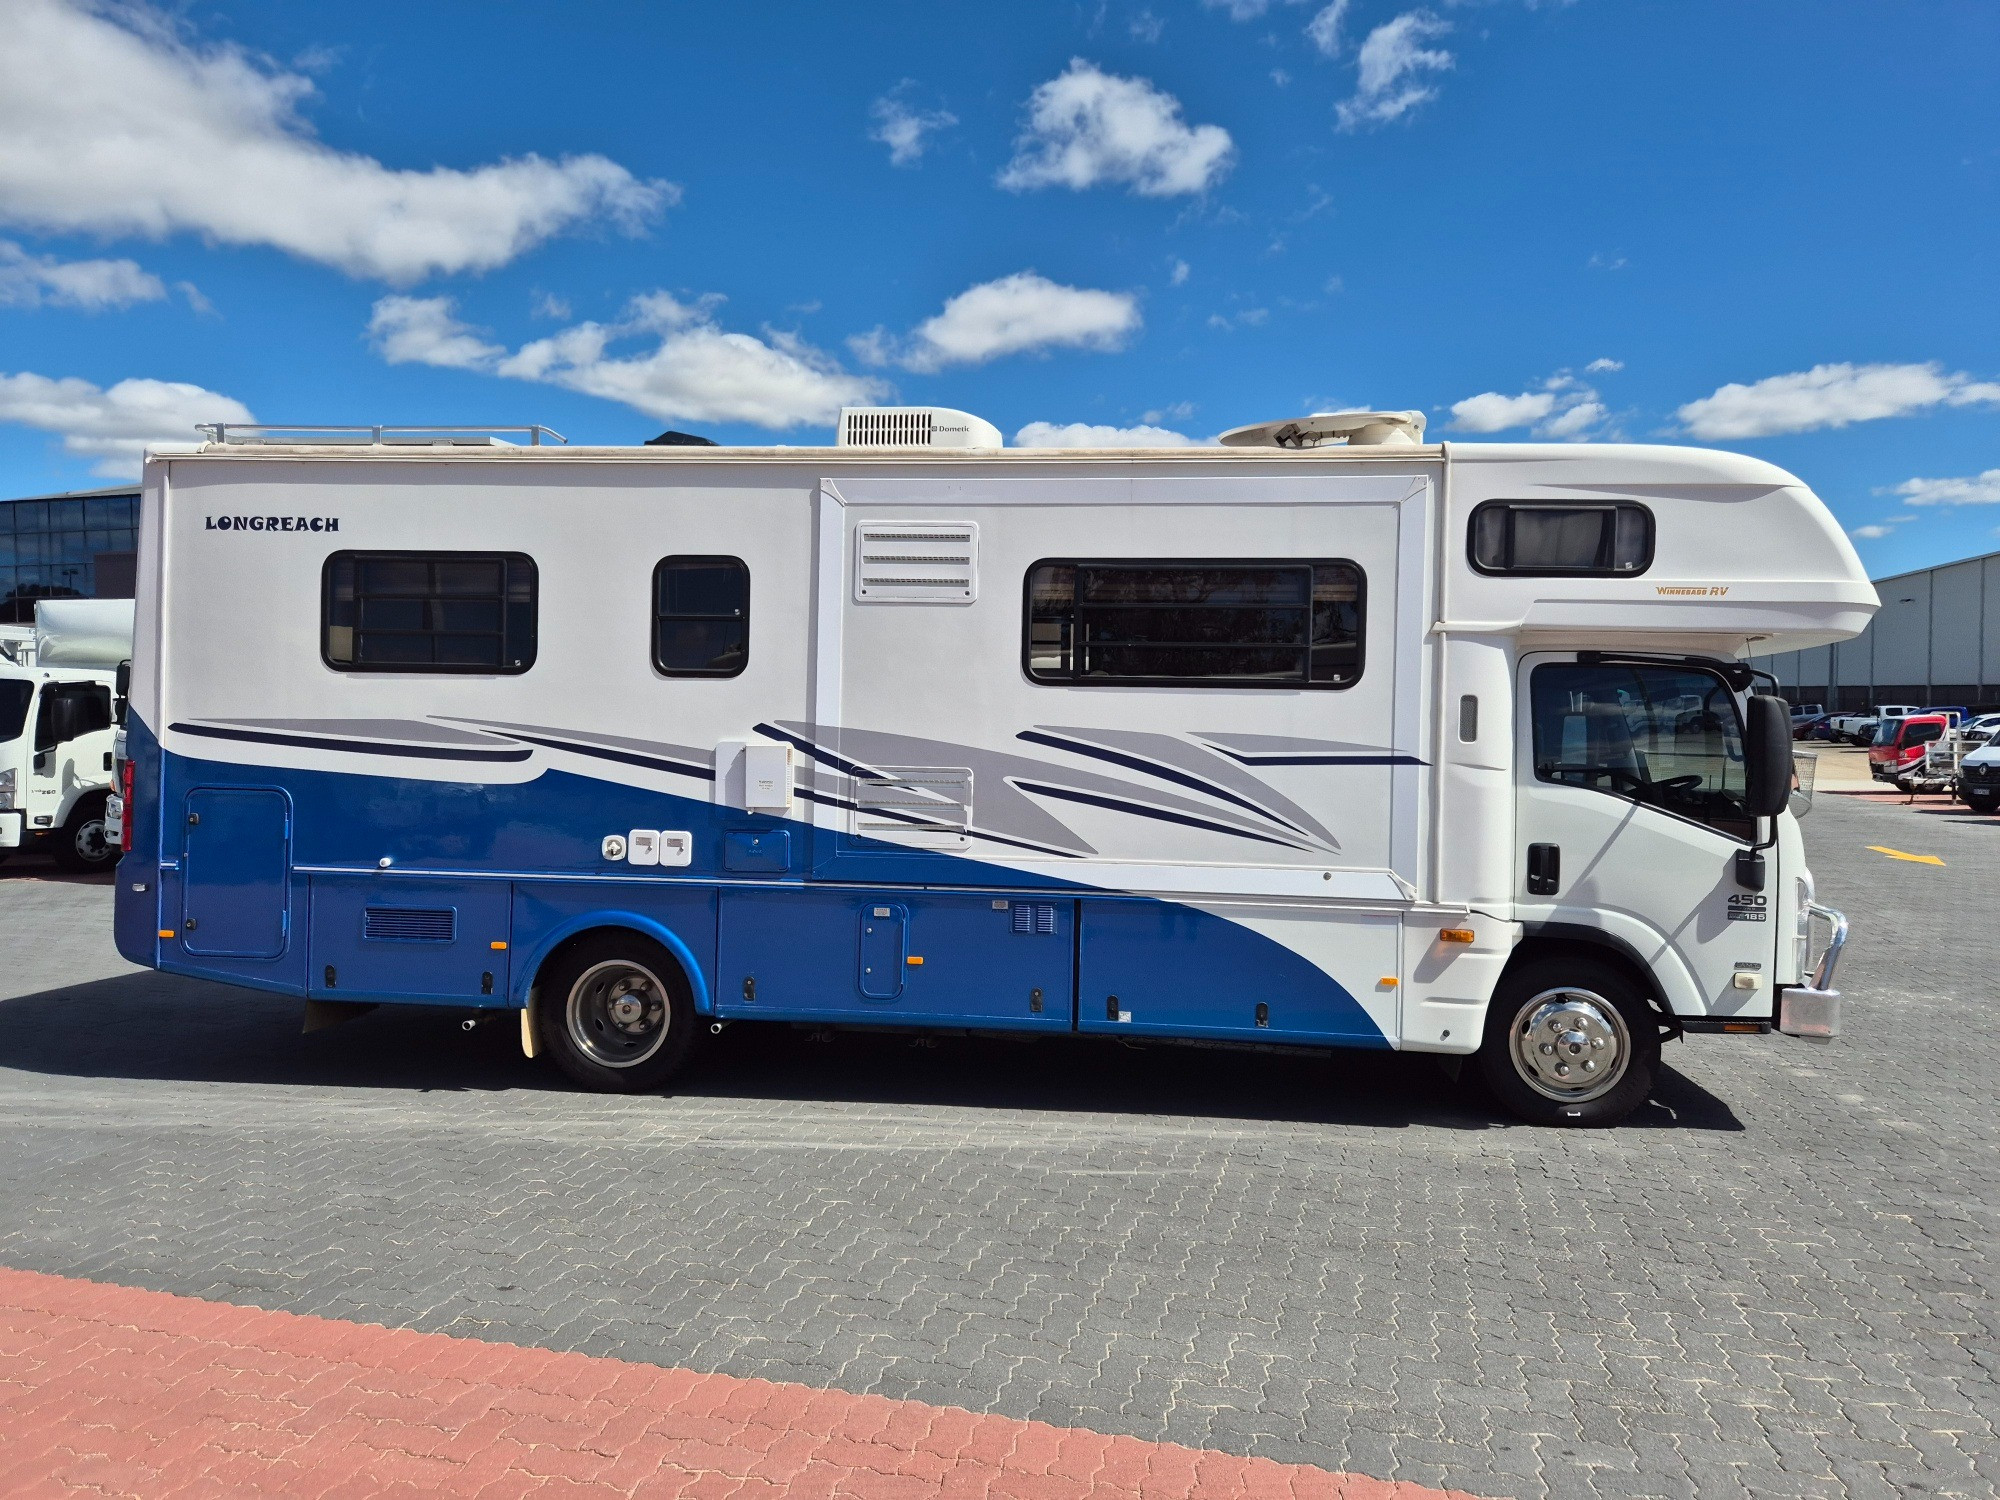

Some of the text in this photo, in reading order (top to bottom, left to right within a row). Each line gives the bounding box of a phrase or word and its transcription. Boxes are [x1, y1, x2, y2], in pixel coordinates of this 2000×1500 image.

[205, 516, 340, 532] LONGREACH
[1709, 586, 1730, 596] RV
[1727, 894, 1767, 906] 450
[1744, 913, 1766, 921] 185
